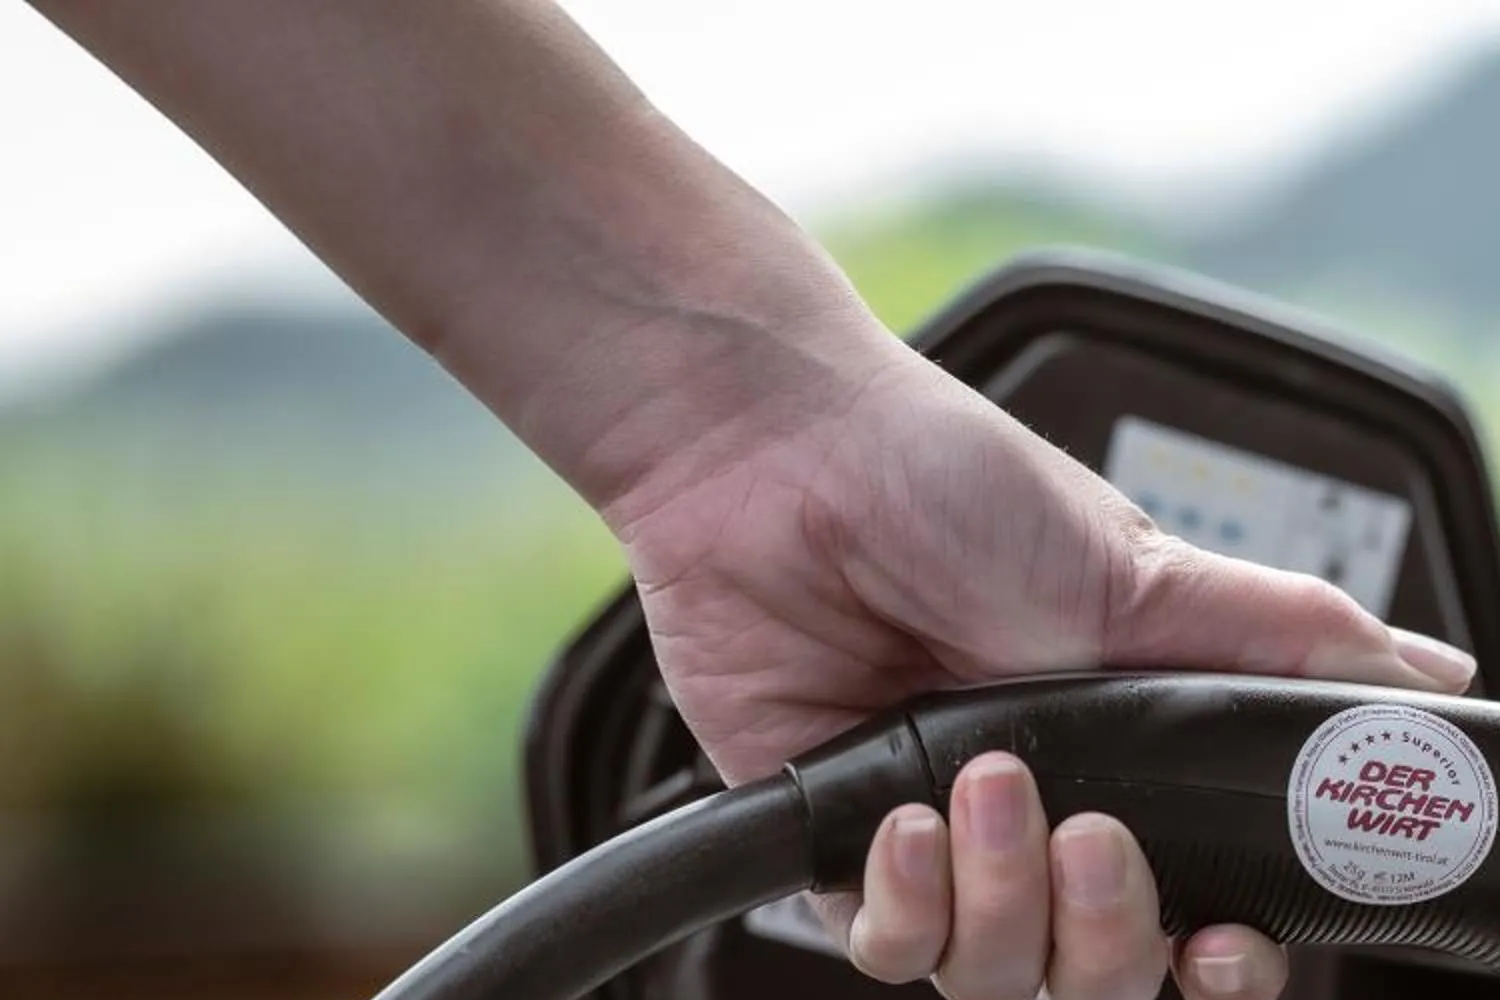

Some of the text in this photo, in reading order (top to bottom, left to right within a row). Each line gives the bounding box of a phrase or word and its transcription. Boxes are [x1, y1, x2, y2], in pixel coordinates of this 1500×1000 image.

[1359, 760, 1436, 791] DER
[1401, 731, 1461, 786] Superior
[1315, 777, 1475, 822] KIRCHEN
[1347, 808, 1441, 841] WIRT
